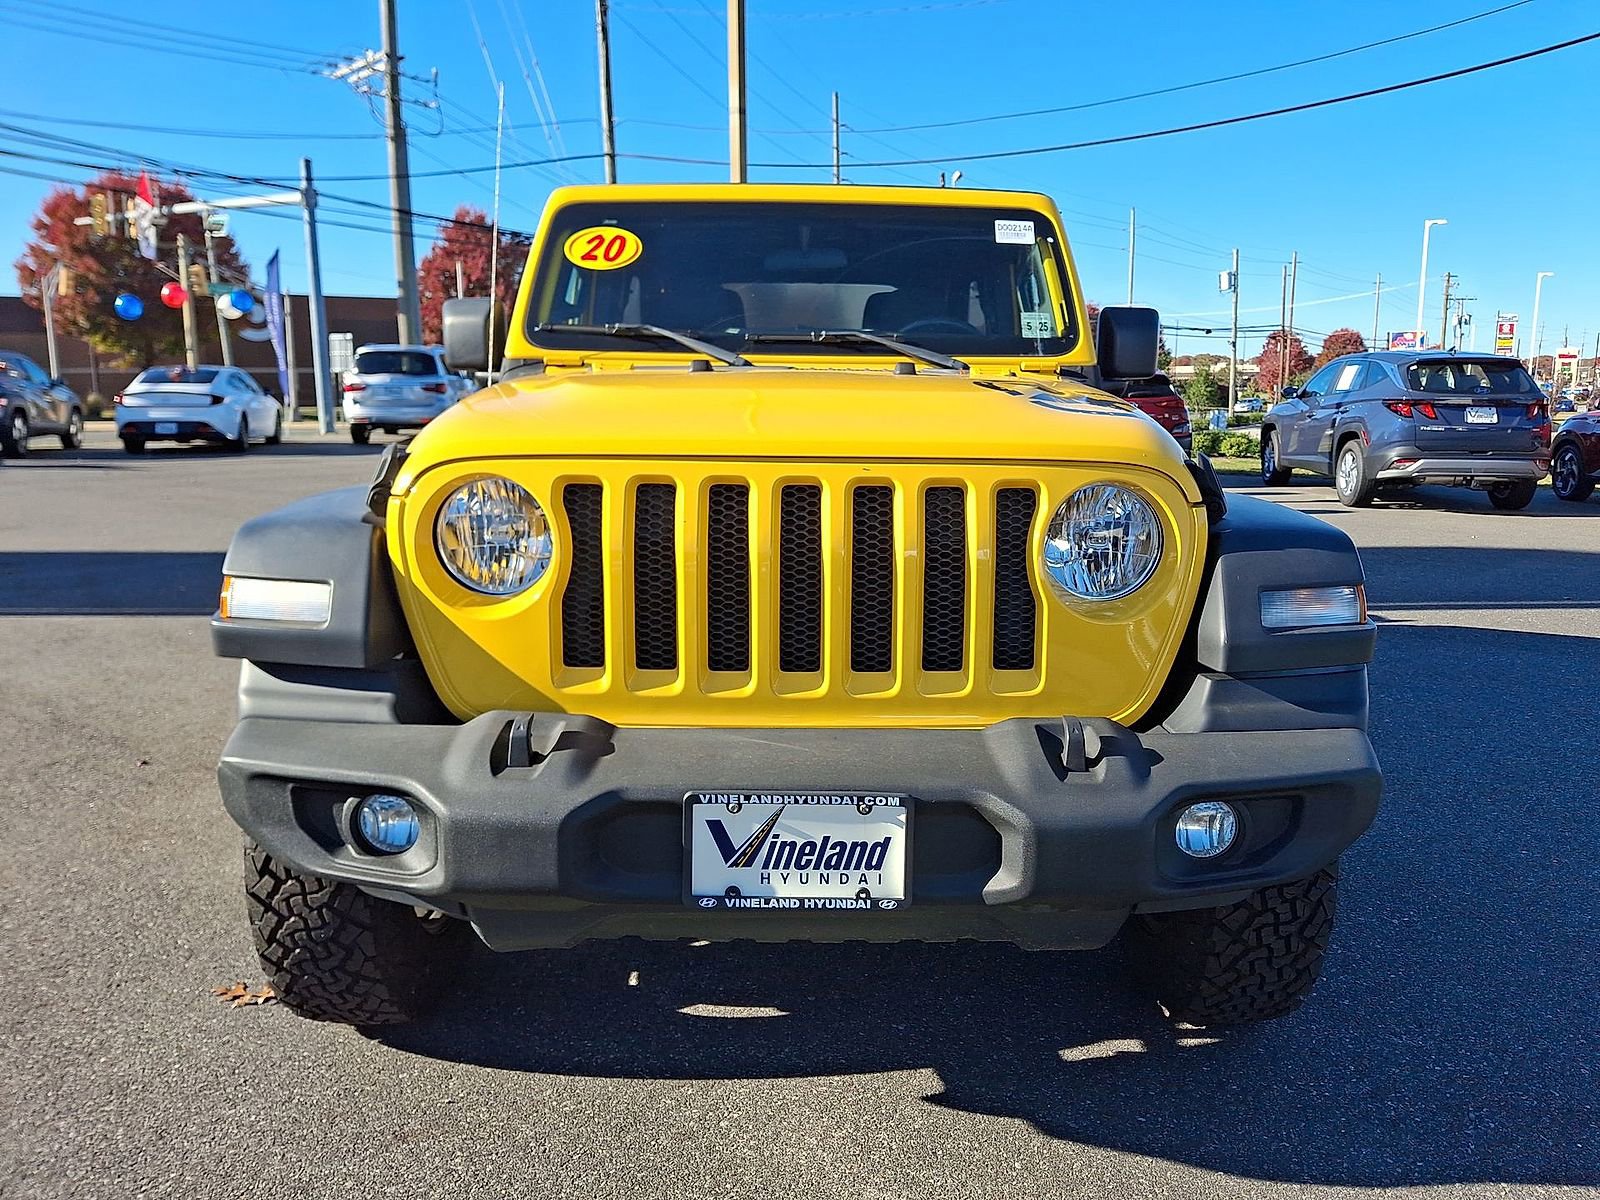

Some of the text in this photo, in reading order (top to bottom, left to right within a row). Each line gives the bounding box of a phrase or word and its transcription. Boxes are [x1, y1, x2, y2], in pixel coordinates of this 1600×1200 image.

[580, 234, 627, 262] 20
[1026, 321, 1049, 332] 5 25
[699, 794, 900, 806] VINELANDHYUNDAI.COM
[705, 804, 892, 871] Vineland
[760, 872, 882, 885] HYUNDAI
[725, 898, 871, 909] VINELAND HYUNDAI
